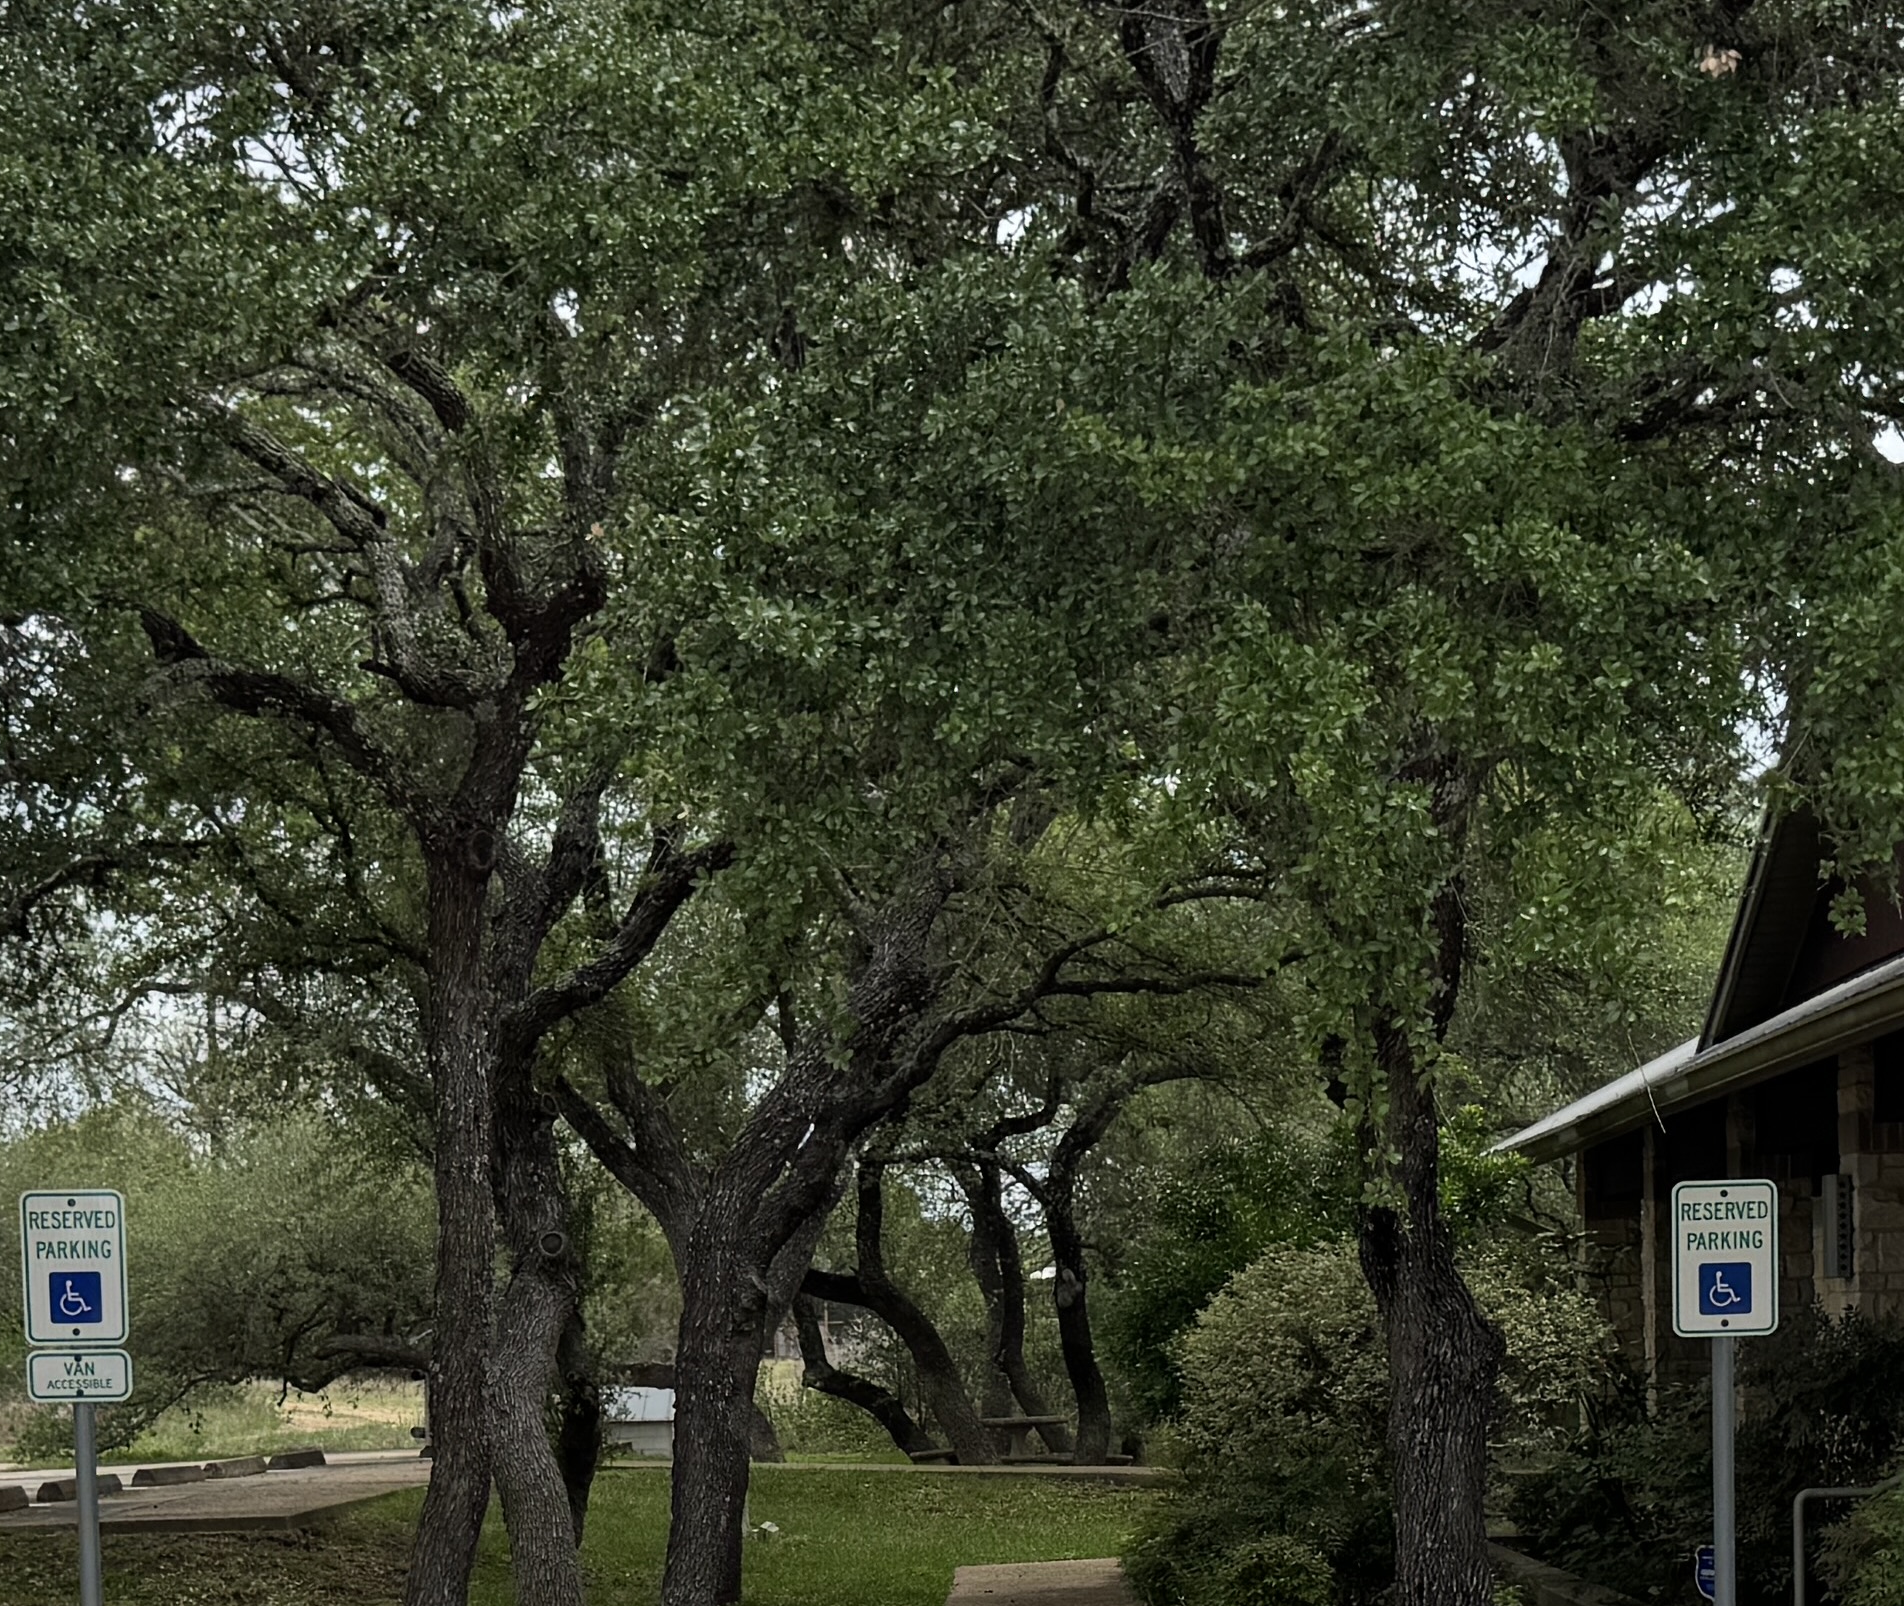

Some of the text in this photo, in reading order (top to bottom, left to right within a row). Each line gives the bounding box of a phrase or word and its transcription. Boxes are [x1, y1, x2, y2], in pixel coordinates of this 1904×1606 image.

[29, 1211, 115, 1230] RESERVED
[1681, 1201, 1768, 1221] RESERVED
[36, 1240, 111, 1259] PARKING
[1687, 1230, 1763, 1251] PARKING
[64, 1362, 95, 1376] VAN
[47, 1378, 113, 1389] ACCESSIBLE
